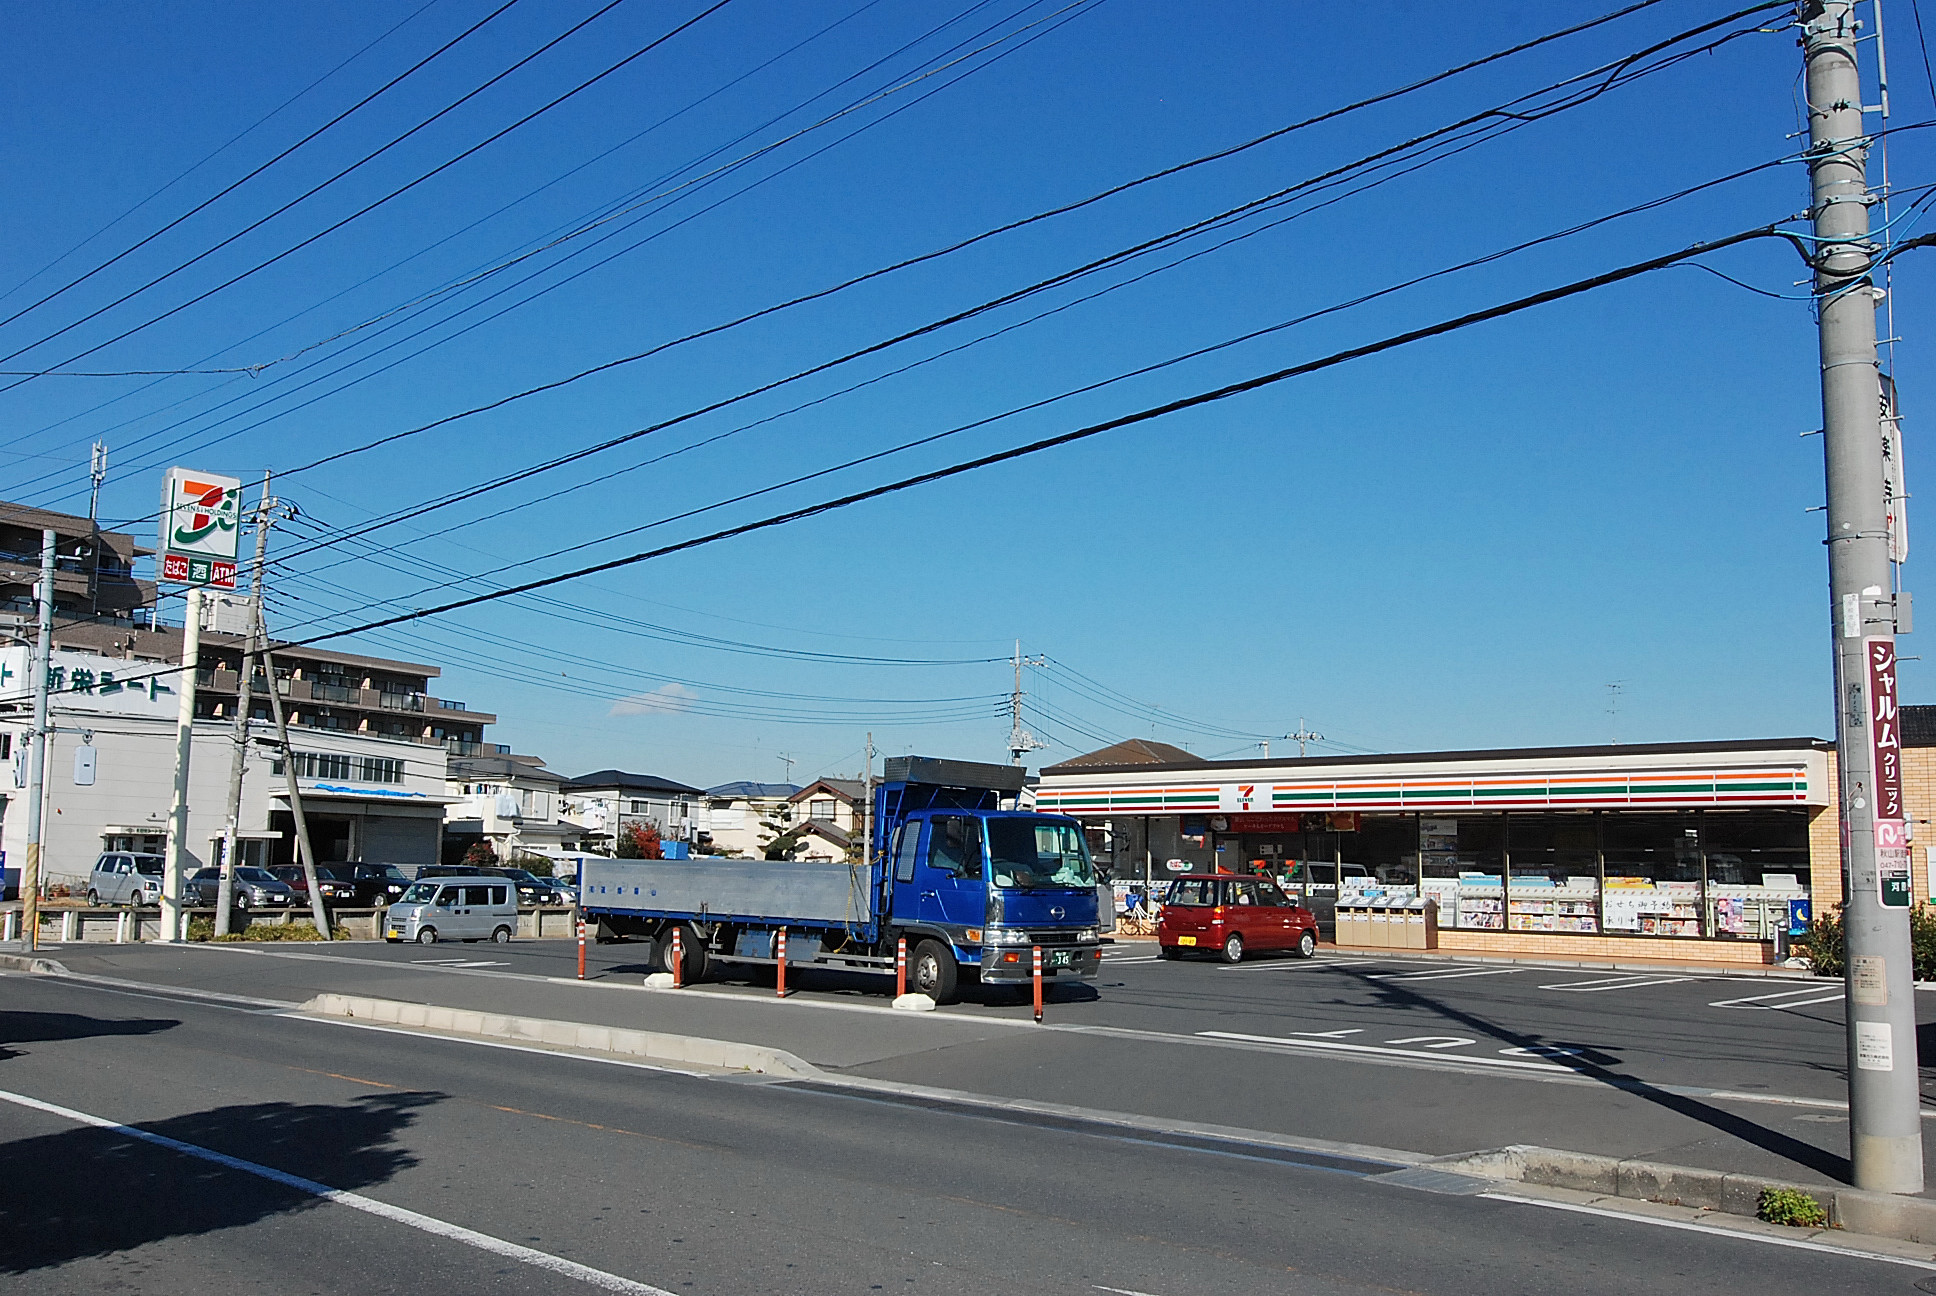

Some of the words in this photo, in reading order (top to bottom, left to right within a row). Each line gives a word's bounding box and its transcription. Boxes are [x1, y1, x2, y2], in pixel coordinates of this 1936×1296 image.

[204, 507, 237, 519] HOLDINGS
[164, 559, 188, 577] たばこ
[192, 563, 208, 579] 酒
[212, 566, 235, 584] ATM
